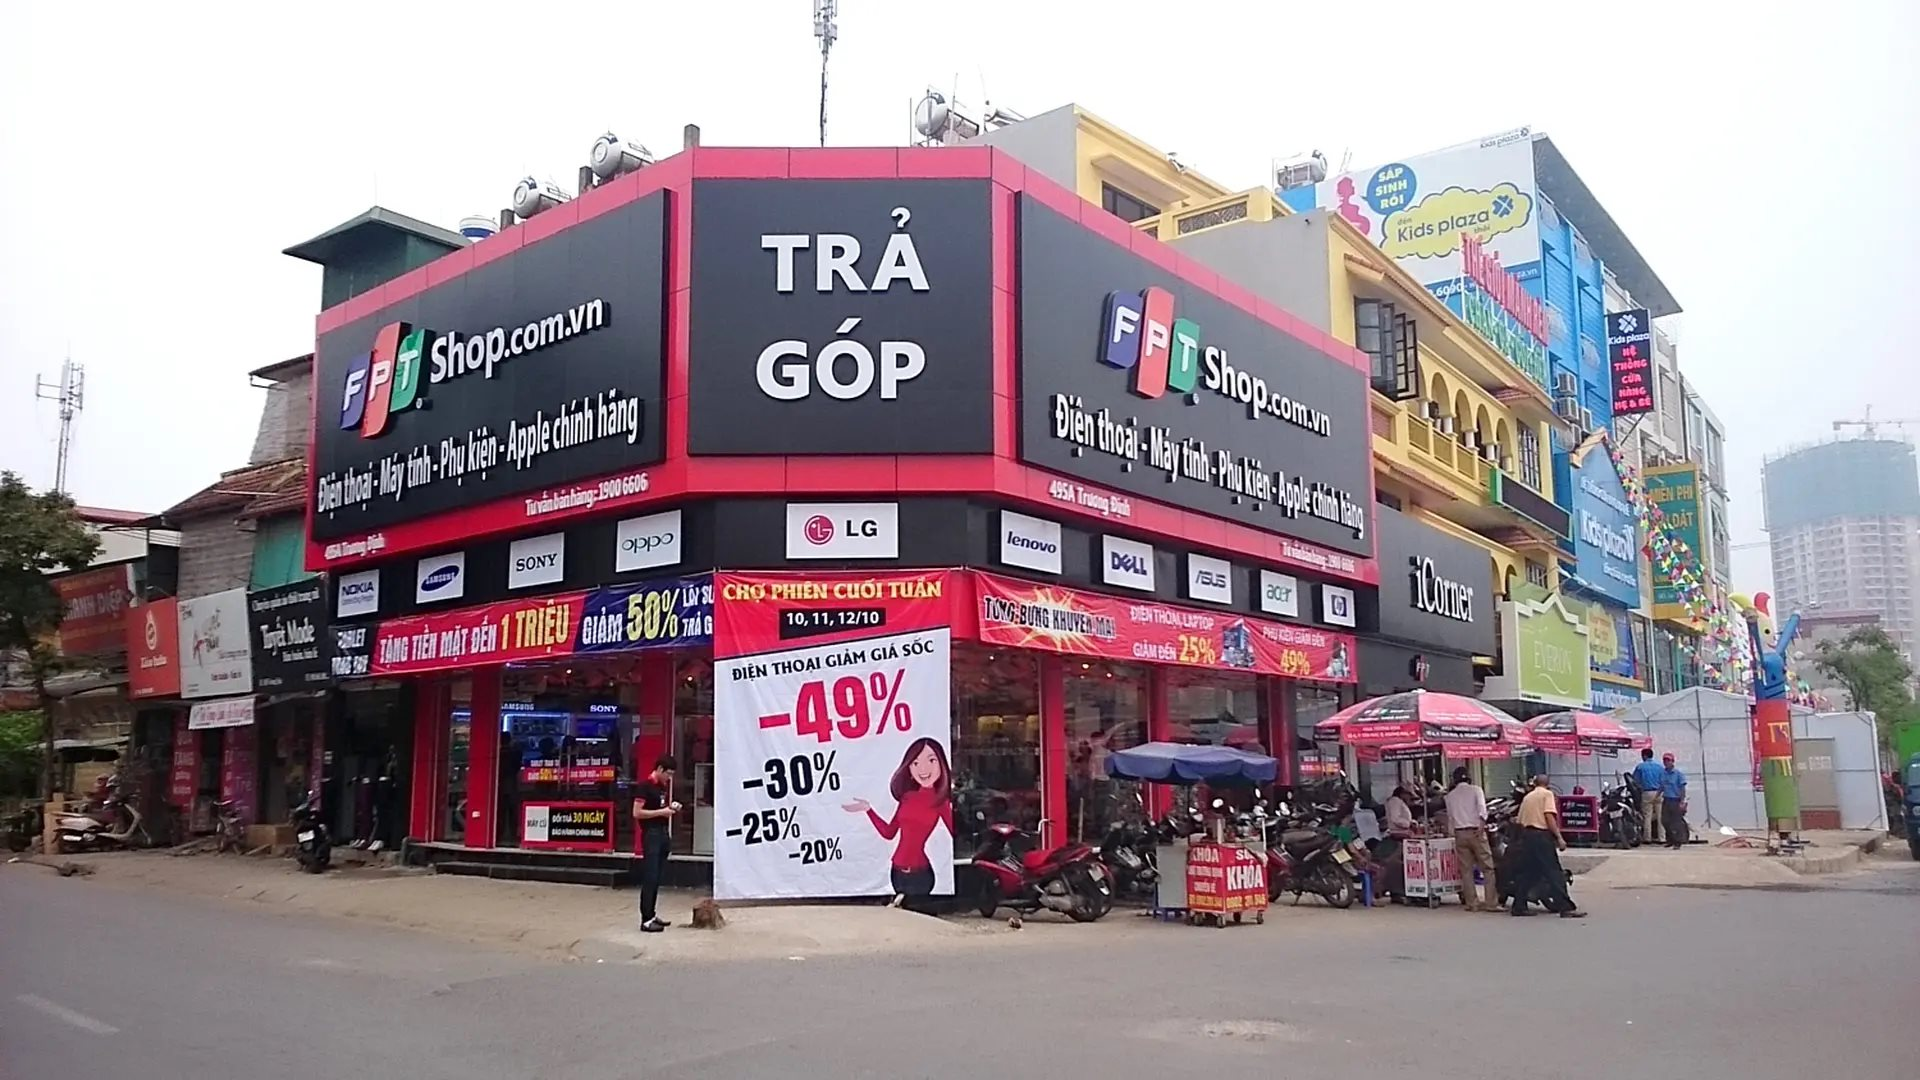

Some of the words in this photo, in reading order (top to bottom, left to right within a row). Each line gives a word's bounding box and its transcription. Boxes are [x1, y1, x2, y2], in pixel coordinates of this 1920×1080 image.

[1375, 179, 1408, 197] SINH
[1397, 222, 1435, 242] Kids
[1438, 209, 1490, 236] plaza
[761, 207, 931, 292] TRẢ
[430, 298, 603, 384] Shop.com.vn
[1111, 304, 1199, 373] FPT
[1607, 334, 1626, 346] Kids
[1626, 332, 1650, 344] plaza
[756, 317, 926, 400] GÓP
[341, 348, 420, 413] FPT
[1204, 345, 1331, 437] Shop.com.vn
[318, 471, 343, 520] Điện
[344, 461, 373, 512] thoại
[379, 452, 405, 502] Máy
[407, 444, 431, 488] tính
[440, 436, 465, 487] Phụ
[467, 426, 497, 481] kiện
[506, 410, 550, 471] Apple
[553, 397, 594, 449] chính
[597, 388, 639, 445] hãng
[1055, 393, 1096, 458] Điện
[1097, 408, 1139, 473] thoại
[1151, 426, 1180, 484] Máy
[1182, 437, 1210, 482] tính
[1219, 450, 1242, 505] Phụ
[1244, 456, 1271, 512] kiện
[1278, 471, 1311, 520] Apple
[1312, 482, 1340, 523] chính
[599, 477, 622, 501] 1900
[622, 472, 649, 496] 6606
[1049, 479, 1076, 503] 495A
[622, 532, 674, 553] oppo
[845, 519, 879, 538] LG
[1007, 530, 1057, 554] lenovo
[1580, 508, 1601, 548] Kids
[516, 553, 558, 572] SONY
[1111, 551, 1148, 576] DELL
[342, 581, 375, 596] NOKIA
[424, 571, 456, 585] SAMSUNG
[722, 582, 766, 602] CHỢ
[771, 580, 829, 600] PHIÊN
[832, 577, 884, 600] CUỐI
[887, 576, 943, 599] TUẦN
[1195, 569, 1227, 589] ASUS
[1416, 555, 1474, 622] iCorner
[1266, 583, 1293, 603] acer
[287, 617, 315, 645] Mode
[582, 606, 624, 646] GIẢM
[626, 587, 681, 642] 50%
[786, 611, 810, 628] 10,
[812, 611, 833, 627] 11,
[836, 610, 880, 626] 12/10
[1129, 605, 1153, 626] ĐIỆN
[1183, 612, 1215, 630] LAPTOP
[379, 633, 409, 668] TẶNG
[412, 624, 438, 660] TIỀN
[440, 626, 469, 662] MẶT
[471, 615, 498, 654] ĐẾN
[501, 613, 511, 650] 1
[515, 598, 570, 653] TRIỆU
[731, 662, 769, 682] ĐIỆN
[771, 657, 822, 677] THOẠI
[825, 647, 867, 668] GIẢM
[870, 642, 899, 663] GIÁ
[902, 637, 935, 656] SỐC
[1132, 640, 1158, 658] GIẢM
[1178, 634, 1216, 665] 25%
[1280, 649, 1311, 675] 49%
[589, 704, 618, 712] SONY
[758, 667, 913, 743] -49%
[742, 750, 841, 800] -30%
[572, 812, 583, 824] 30
[583, 810, 606, 824] NGÀY
[725, 806, 801, 846] -25%
[788, 837, 843, 866] -20%
